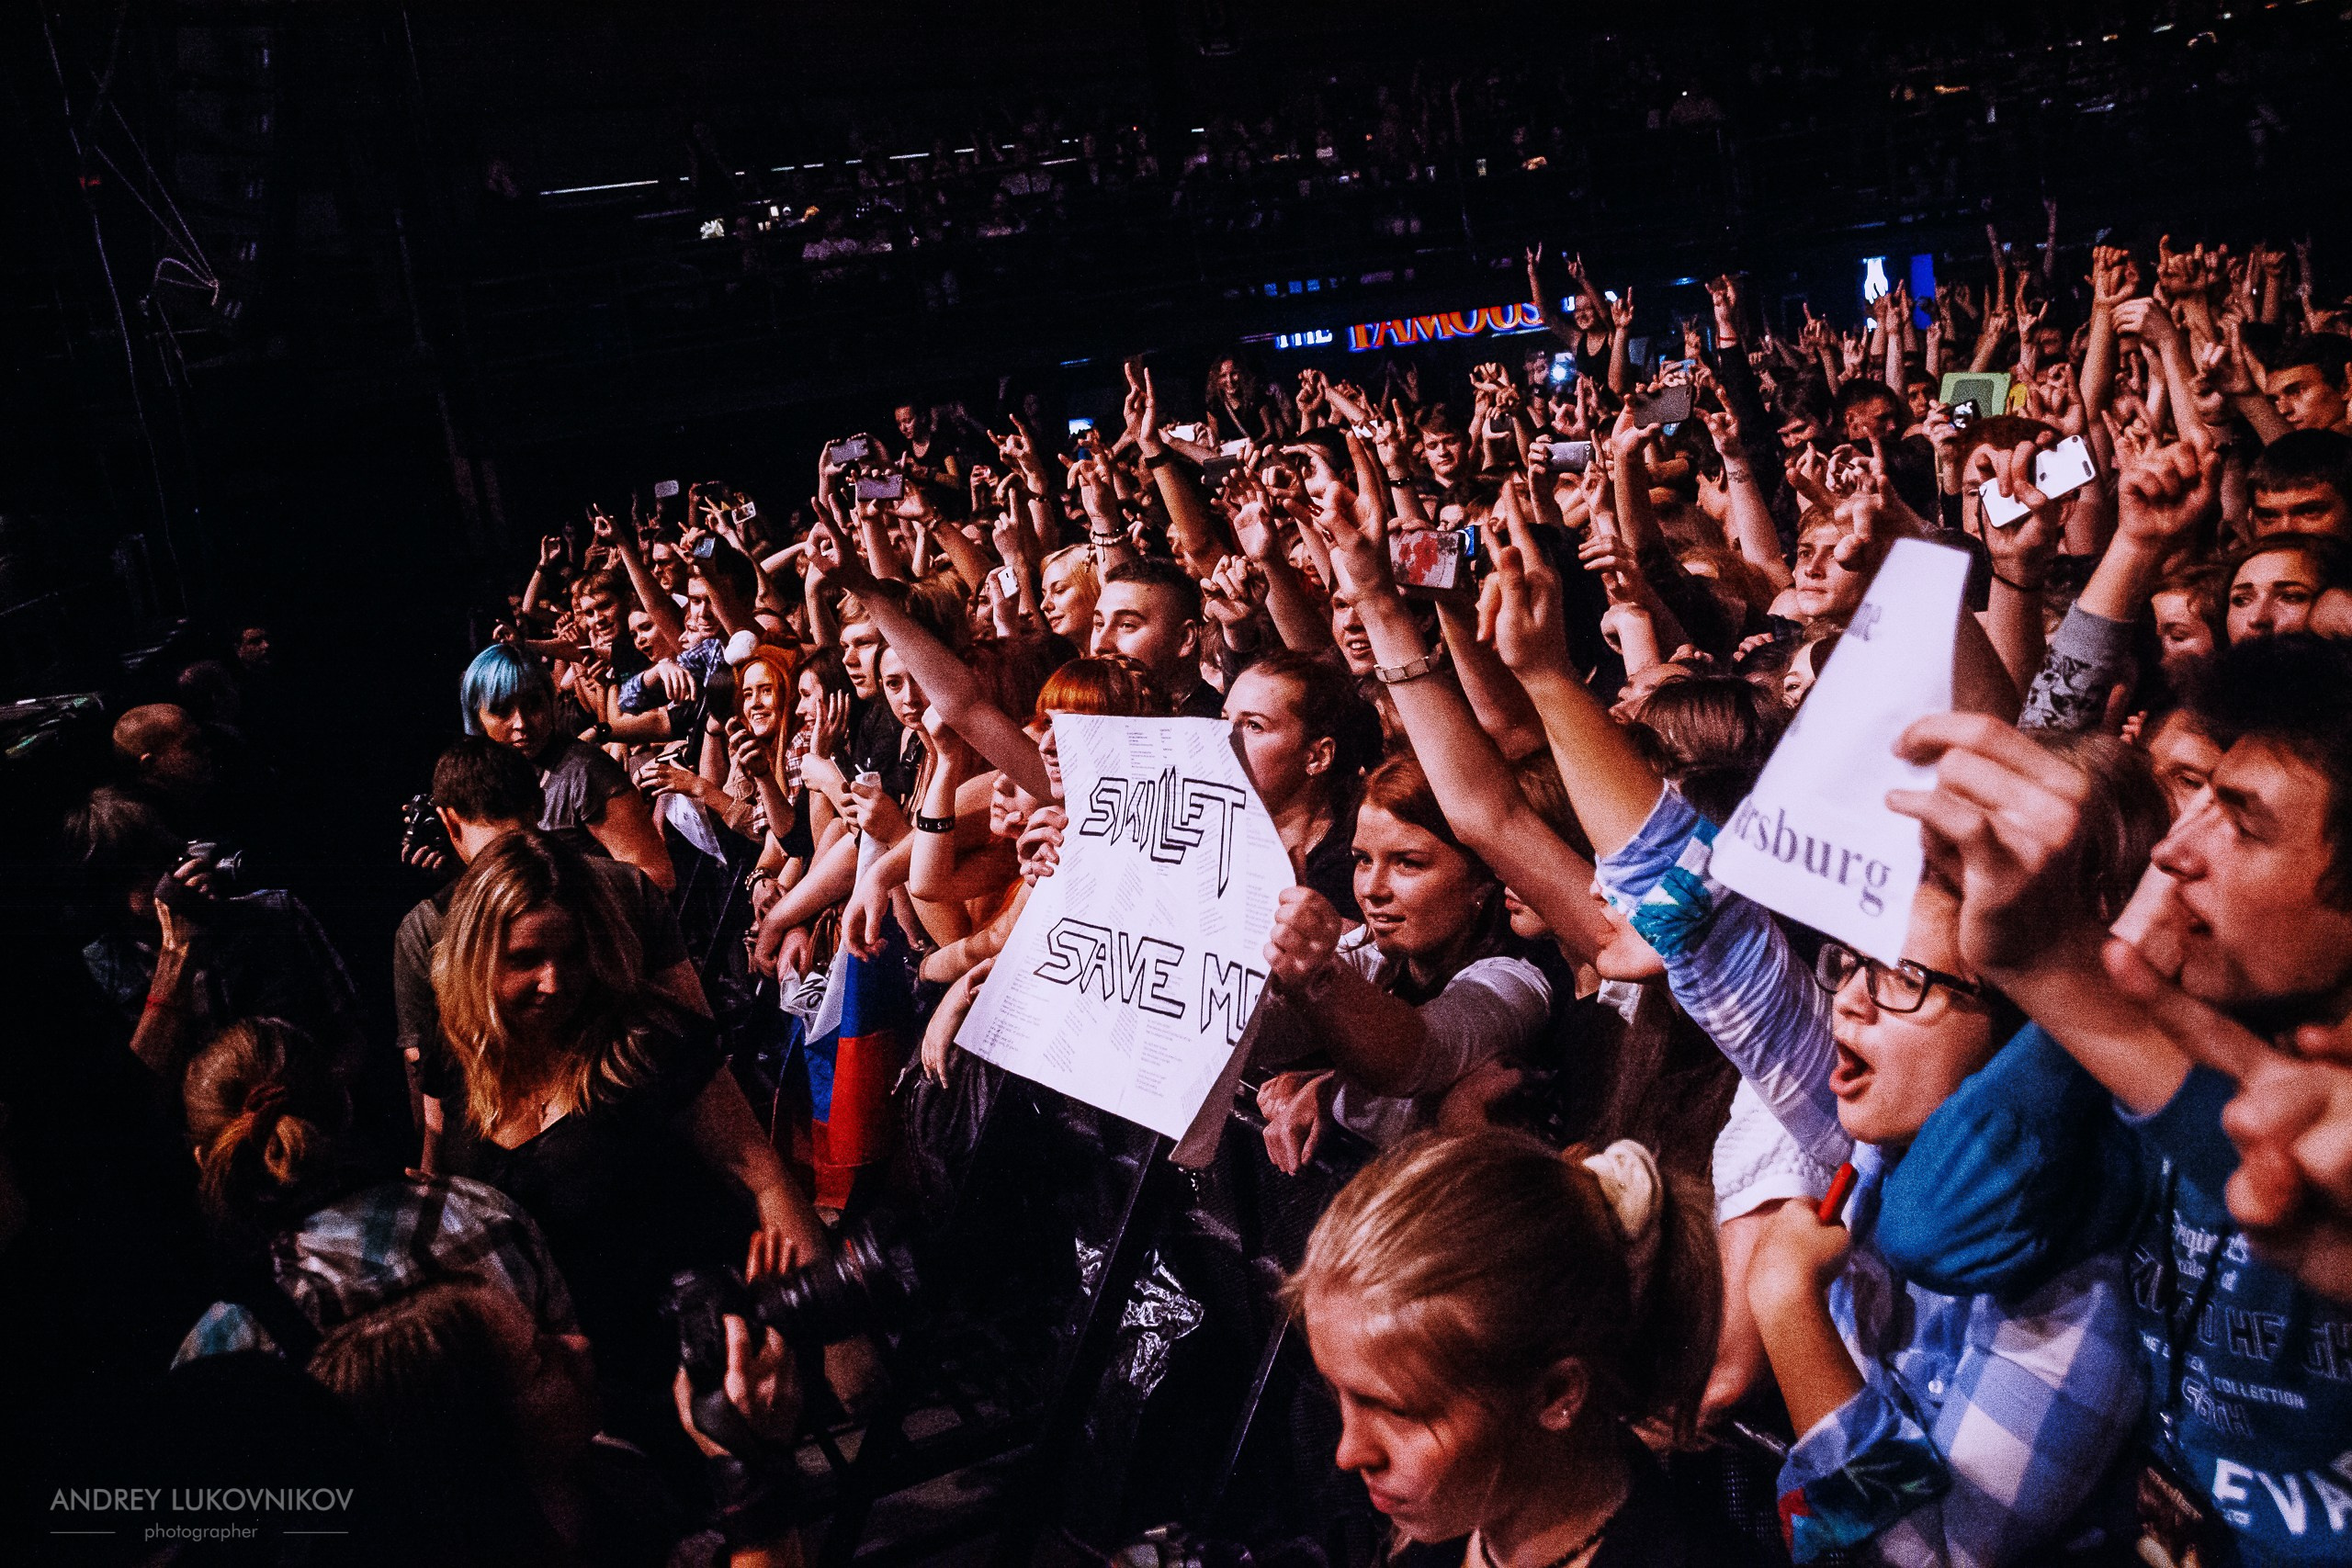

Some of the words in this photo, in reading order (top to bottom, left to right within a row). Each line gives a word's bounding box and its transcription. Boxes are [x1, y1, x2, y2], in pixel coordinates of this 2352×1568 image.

[1079, 765, 1247, 900] SKILLET
[1734, 798, 1892, 918] rsburg
[1033, 917, 1186, 1020] SAVE
[2212, 1376, 2308, 1410] COLLECTION
